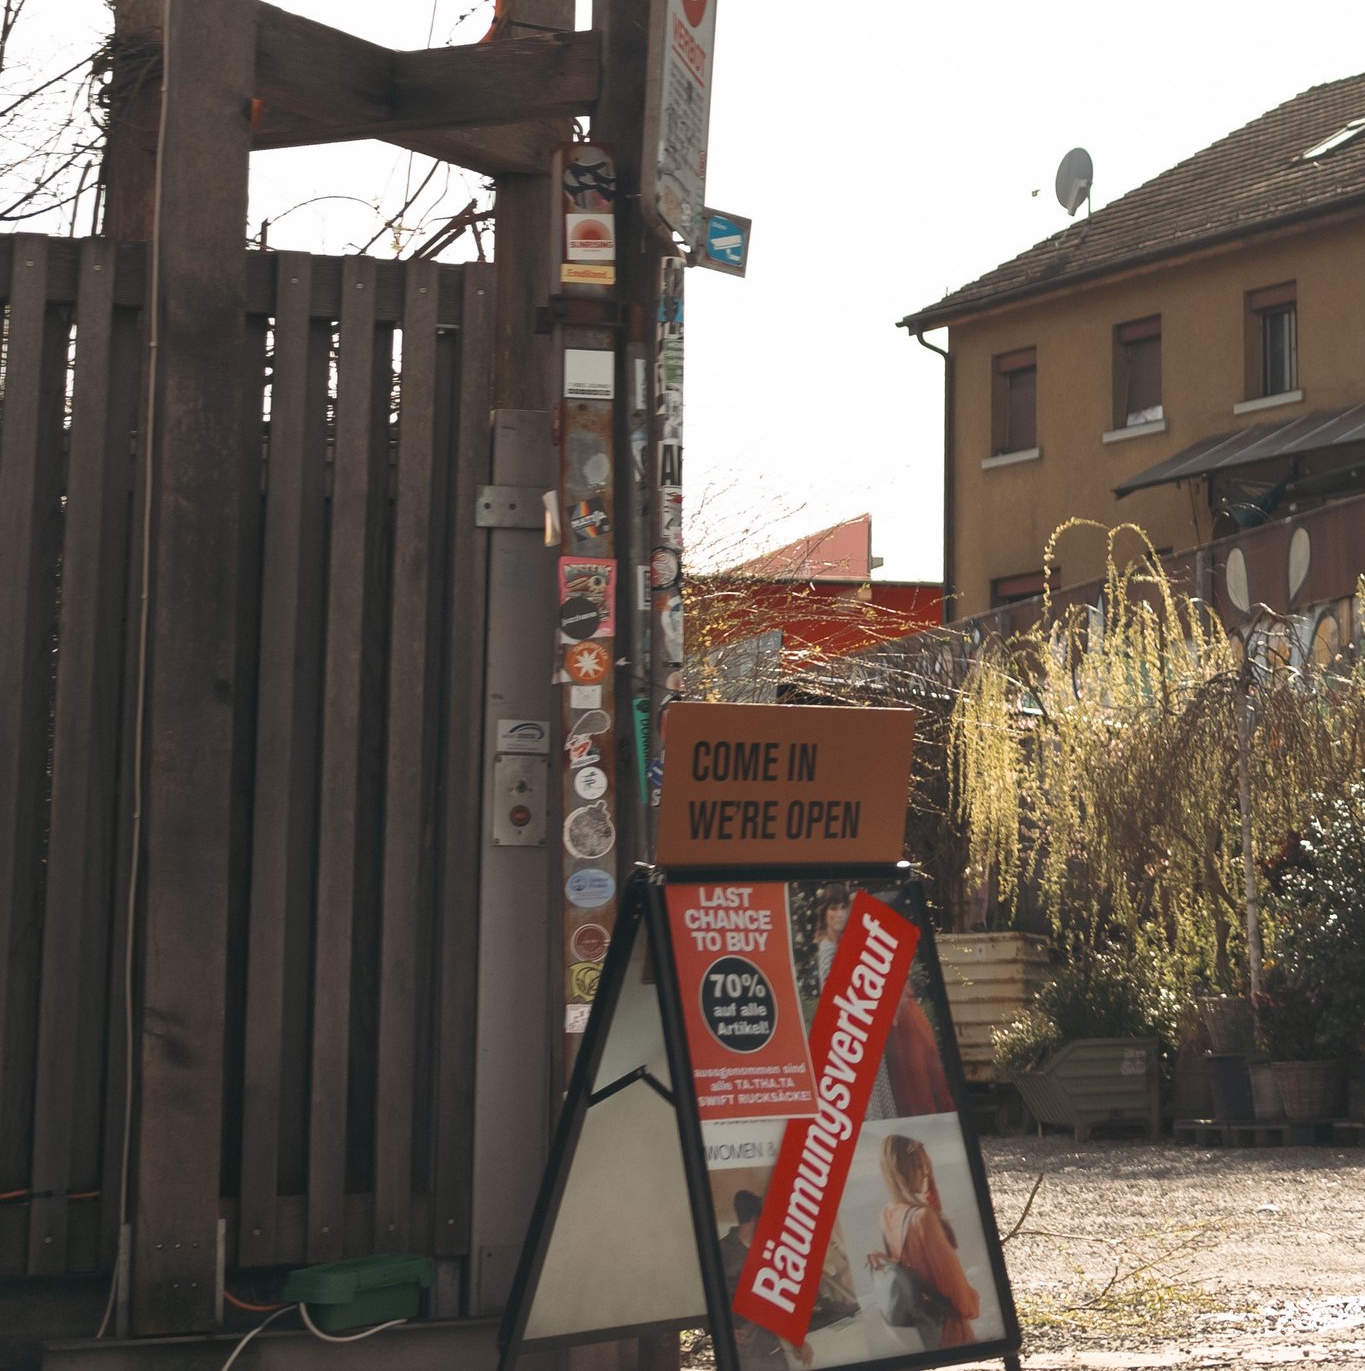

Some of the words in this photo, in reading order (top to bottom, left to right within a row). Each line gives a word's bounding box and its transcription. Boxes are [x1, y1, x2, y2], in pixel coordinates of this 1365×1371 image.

[692, 740, 780, 782] COME
[787, 743, 818, 782] IN
[689, 800, 778, 840] WE'RE
[786, 800, 861, 839] OPEN
[699, 887, 753, 908] LAST
[684, 909, 773, 931] CHANCE
[691, 932, 722, 952] TO
[726, 931, 769, 952] BUY
[709, 973, 767, 999] 70%
[713, 1003, 737, 1017] auf
[739, 1002, 768, 1016] alle
[717, 1019, 770, 1036] Artikel!
[783, 1061, 807, 1074] sind
[710, 1079, 733, 1091] alle
[697, 1094, 734, 1107] SWIFT
[750, 913, 899, 1313] Räumungsverkauf
[705, 1142, 763, 1161] WOMEN
